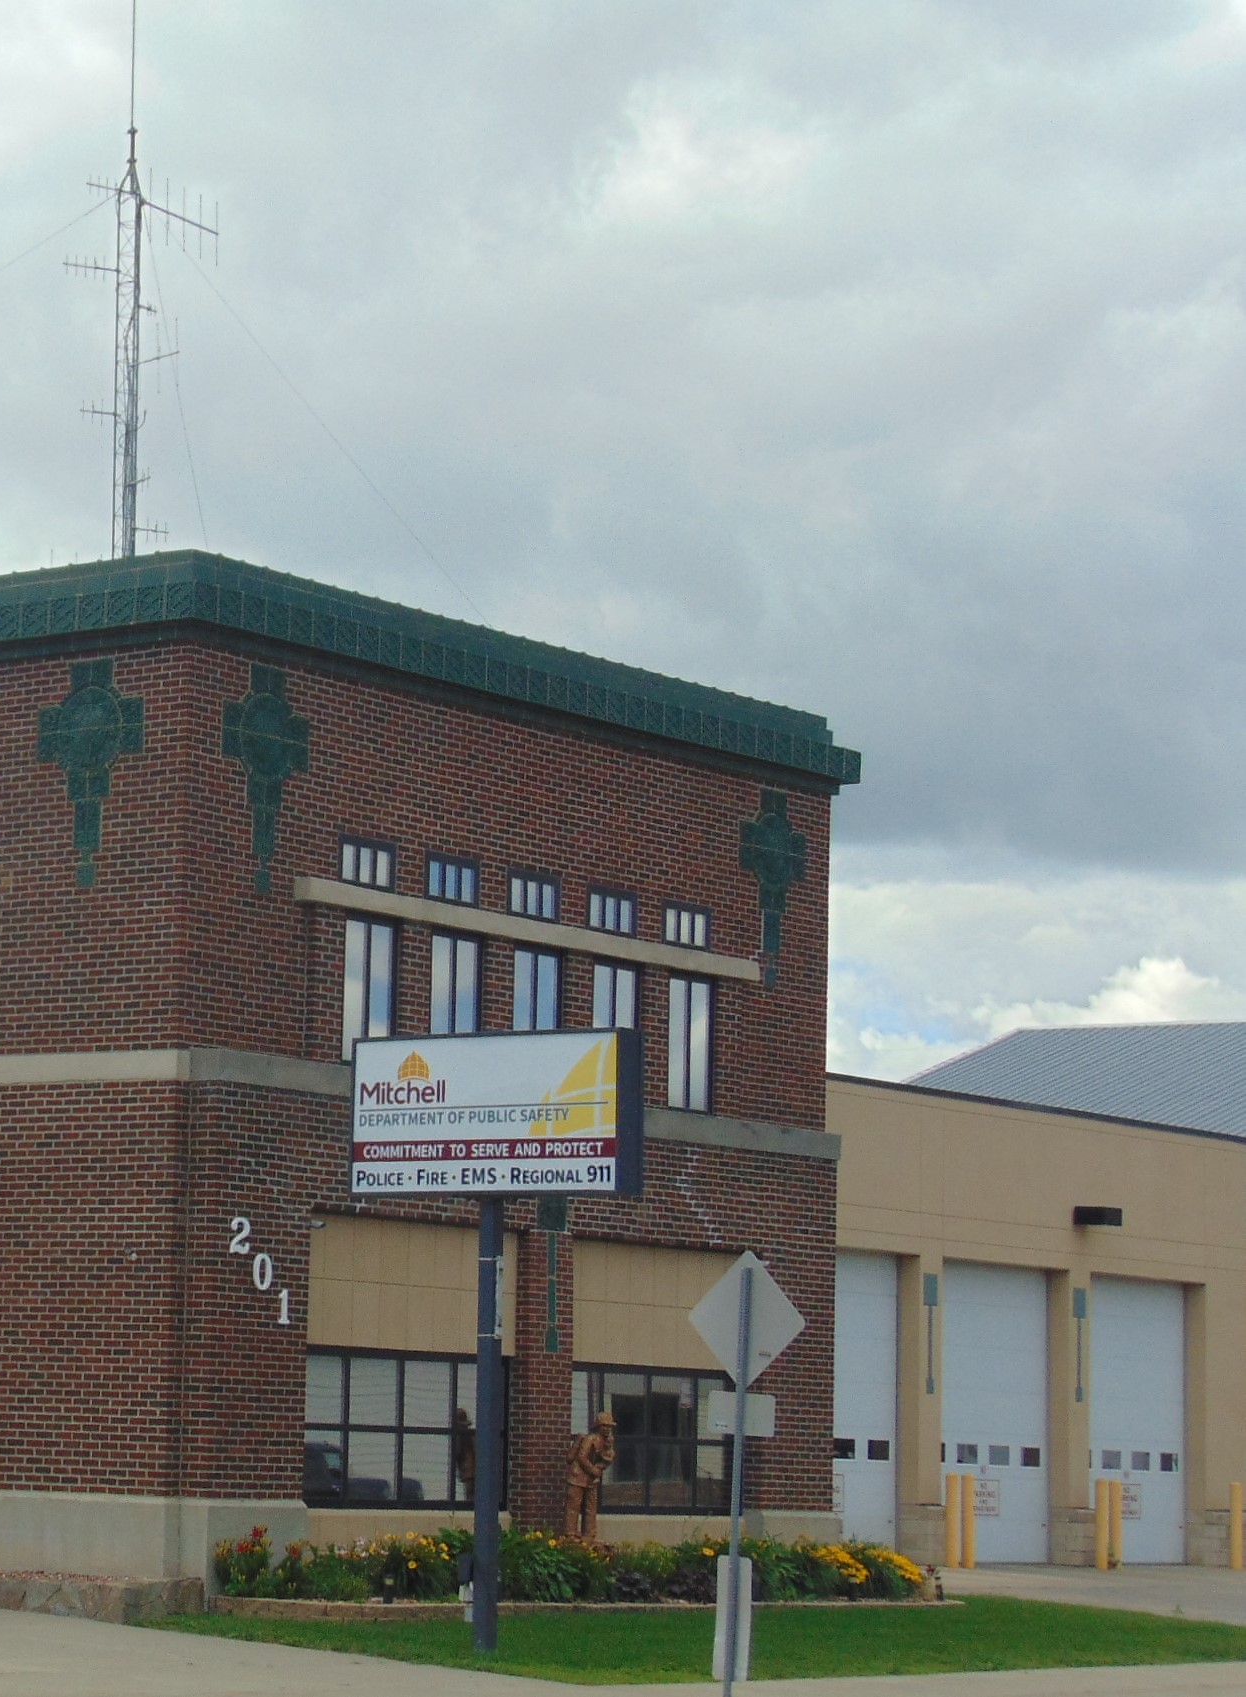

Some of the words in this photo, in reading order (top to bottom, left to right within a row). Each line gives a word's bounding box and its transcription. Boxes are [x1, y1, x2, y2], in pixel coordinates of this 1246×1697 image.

[359, 1079, 446, 1105] Mitchell
[359, 1112, 444, 1127] DEPARTMENT
[448, 1111, 465, 1124] OF
[468, 1109, 516, 1124] PUBLIC
[520, 1107, 569, 1123] SAFETY
[363, 1144, 444, 1159] COMMITMENT
[449, 1143, 466, 1158] TO
[471, 1143, 509, 1157] SERVE
[514, 1142, 541, 1157] AND
[545, 1141, 603, 1156] PROTECT
[356, 1170, 404, 1187] POLICE
[416, 1168, 448, 1186] FIRE
[461, 1167, 497, 1185] EMS
[510, 1166, 583, 1185] REGIONAL
[586, 1164, 611, 1184] 911
[229, 1216, 290, 1325] 201
